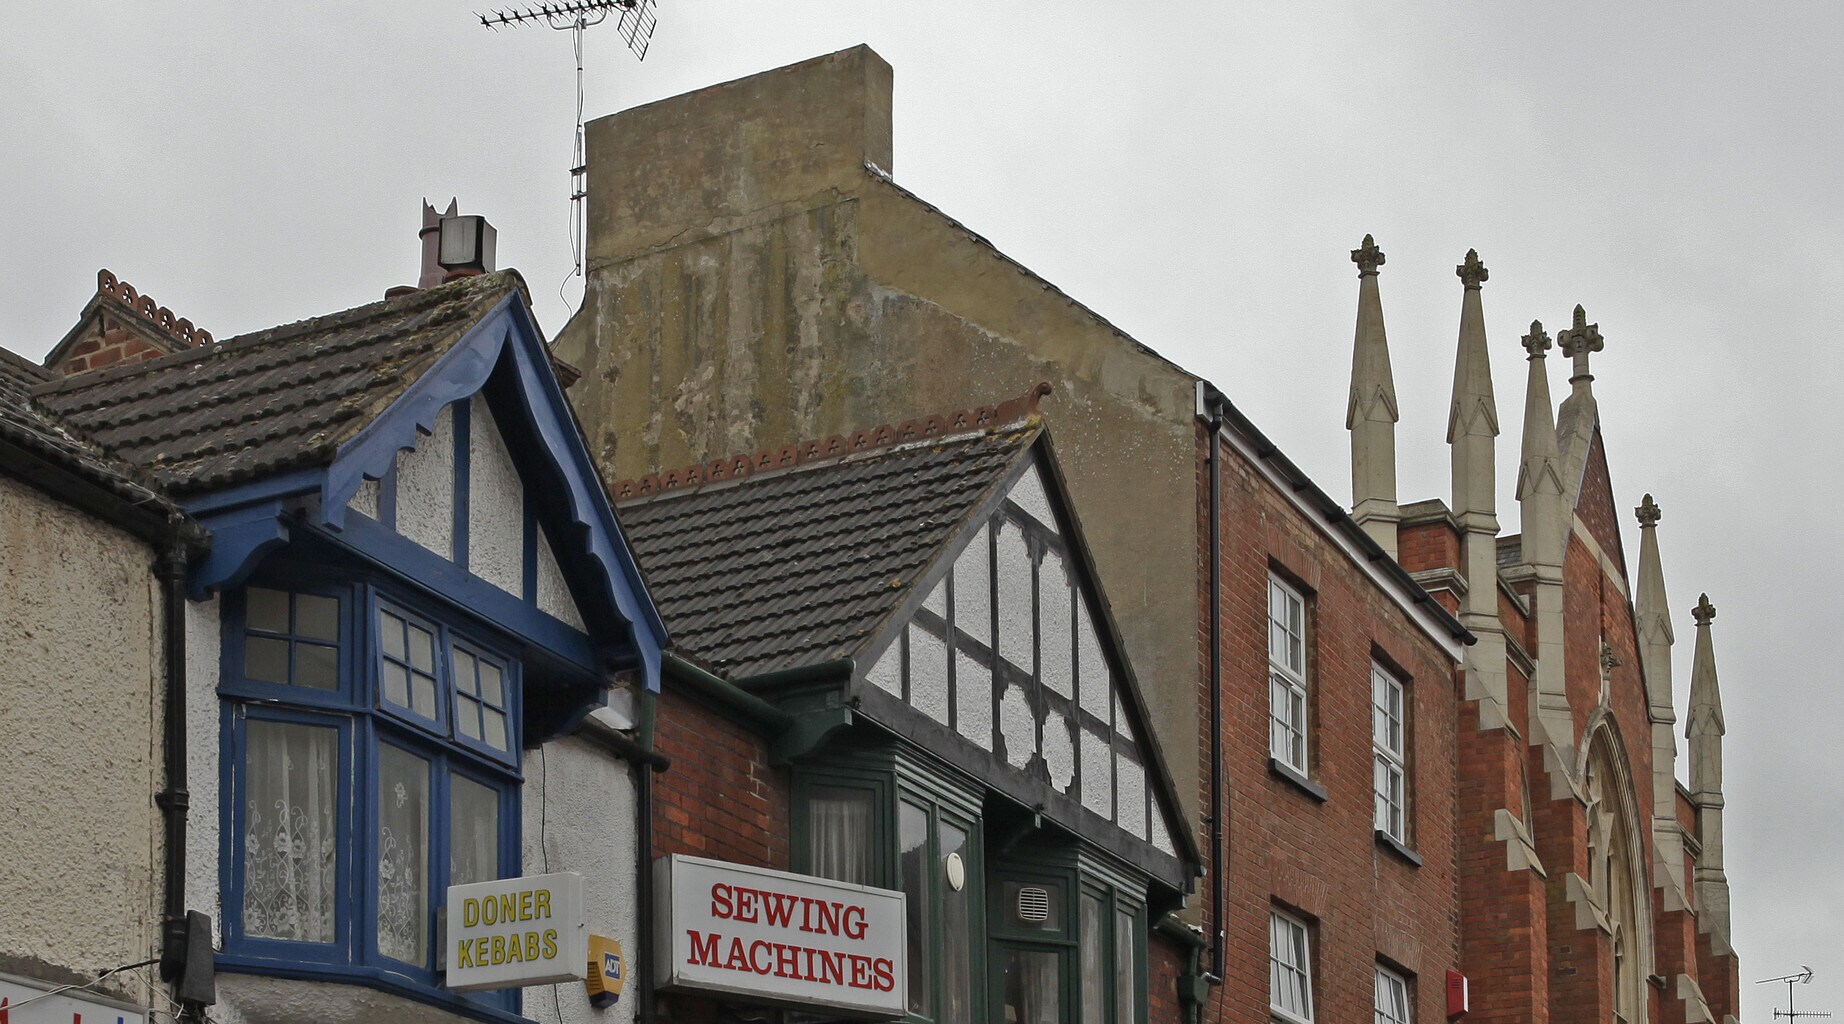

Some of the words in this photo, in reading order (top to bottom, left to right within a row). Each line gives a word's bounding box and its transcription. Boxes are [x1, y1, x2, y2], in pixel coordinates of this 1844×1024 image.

[463, 888, 553, 927] DONER
[711, 882, 869, 941] SEWING
[458, 929, 558, 969] KEBABS
[605, 958, 620, 974] ADT
[686, 929, 896, 992] MACHINES
